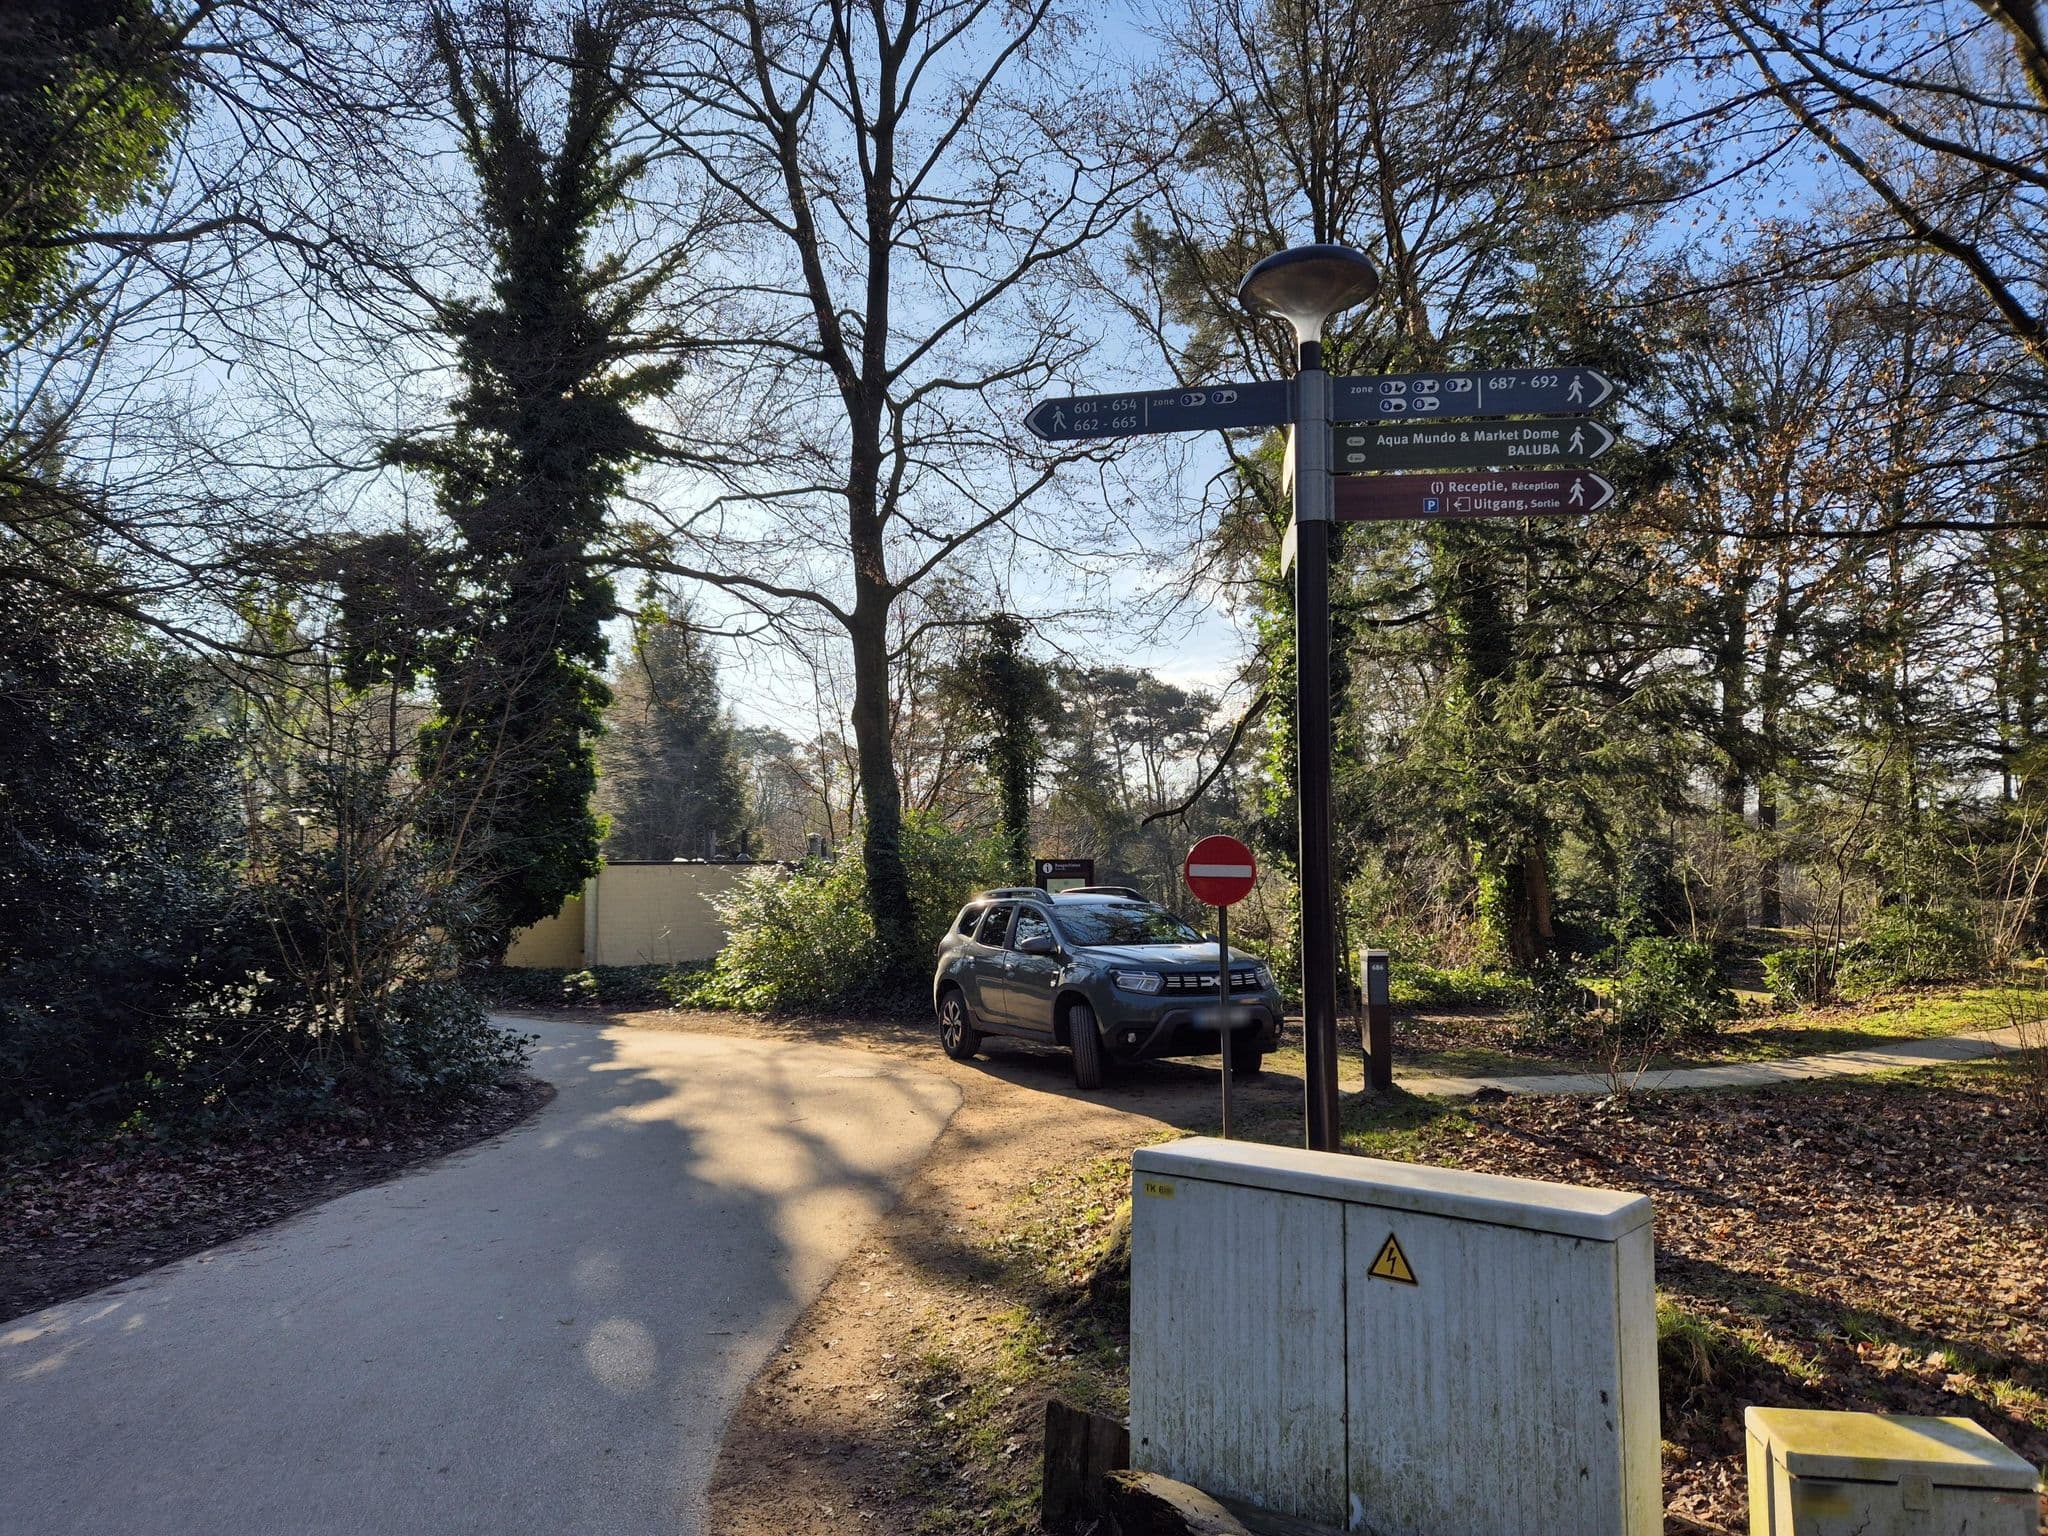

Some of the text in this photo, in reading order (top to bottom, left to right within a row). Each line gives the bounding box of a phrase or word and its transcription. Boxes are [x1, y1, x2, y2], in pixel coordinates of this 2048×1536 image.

[1350, 385, 1374, 394] zone
[1489, 377, 1516, 390] 687
[1531, 375, 1558, 388] 692
[1073, 402, 1098, 414] 601
[1111, 399, 1138, 412] 654
[1152, 398, 1175, 406] zone
[1073, 419, 1098, 431] 662
[1112, 416, 1137, 429] 665
[1376, 434, 1409, 447] Aqua
[1413, 432, 1456, 444] Mundo
[1460, 431, 1470, 442] &
[1474, 430, 1518, 442] Market
[1523, 428, 1560, 440] Dome
[1508, 444, 1561, 456] BALUBA
[1431, 480, 1560, 494] (i) Receptie, Réception
[1474, 498, 1560, 512] Uitgang, Sortie
